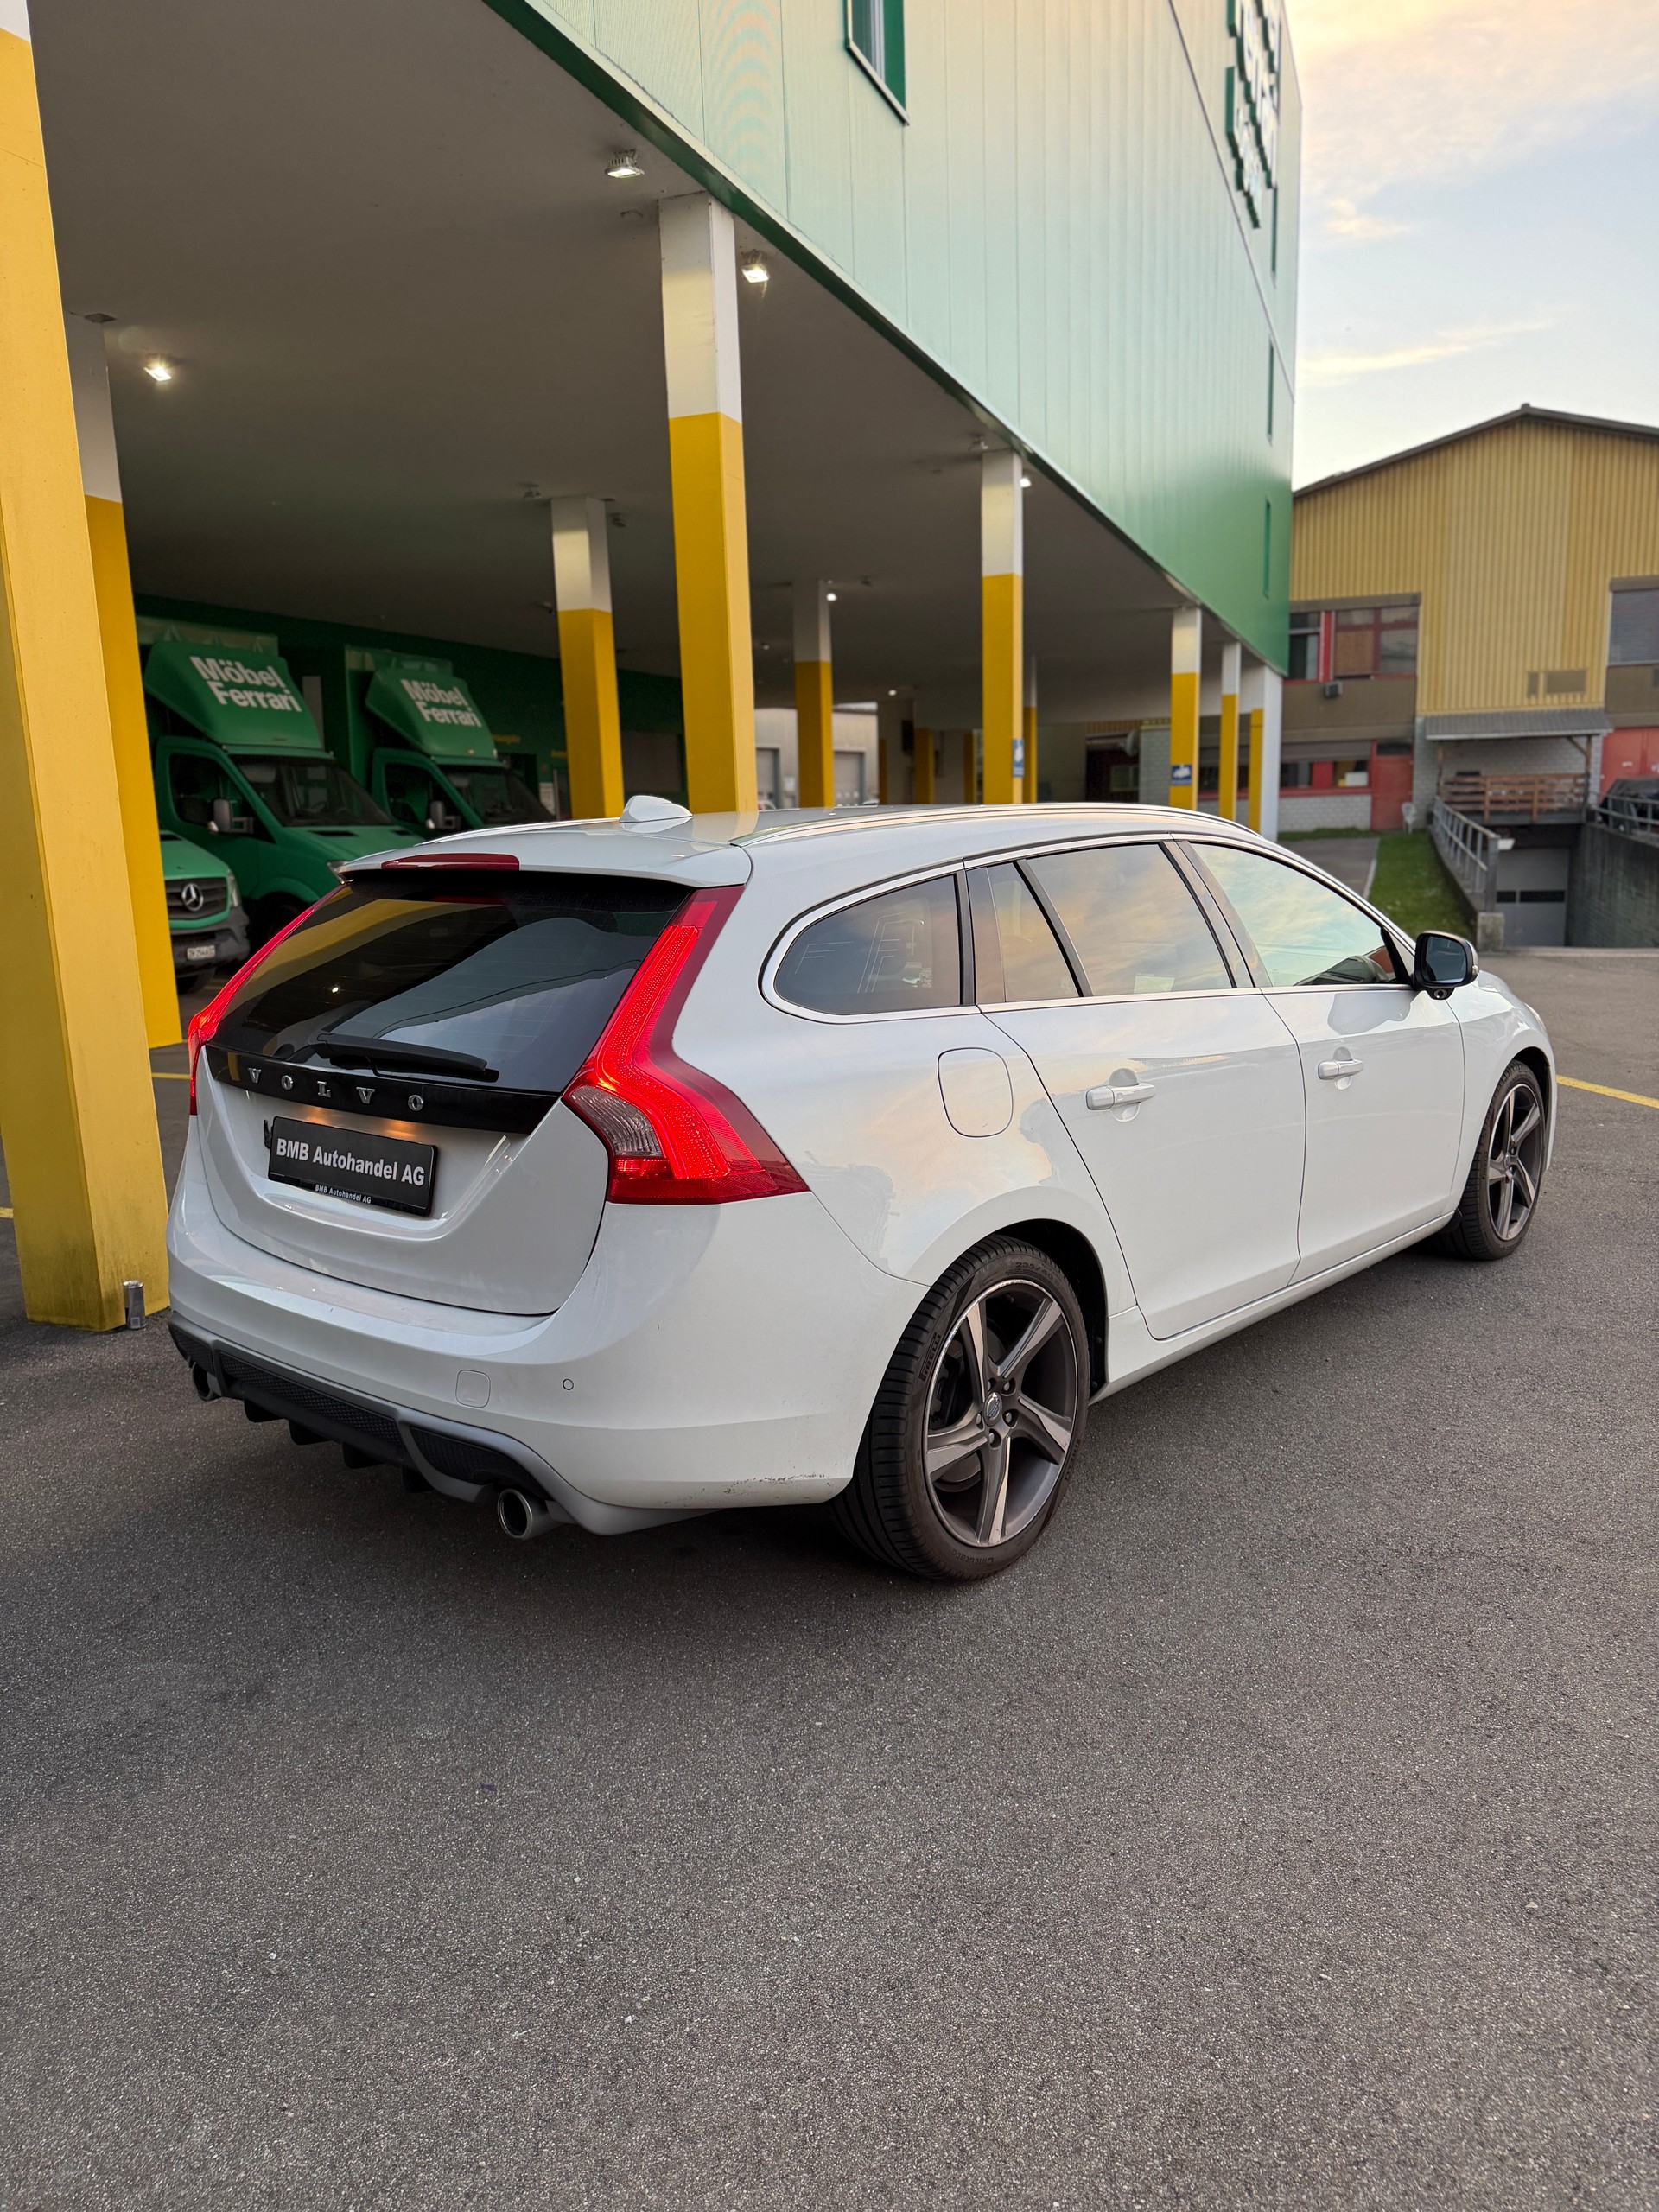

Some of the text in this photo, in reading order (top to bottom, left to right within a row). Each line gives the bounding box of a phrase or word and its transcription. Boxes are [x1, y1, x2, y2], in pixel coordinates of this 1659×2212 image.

[190, 656, 286, 689] Möbel
[207, 680, 302, 712] Ferrari
[400, 678, 469, 706] Möbel
[415, 701, 482, 728] Ferrari
[247, 1067, 424, 1112] VOLVO
[276, 1137, 425, 1186] BMB Autohandel AG
[315, 1184, 372, 1205] BMB Autohandel AG
[918, 1332, 941, 1382] PIRELLI
